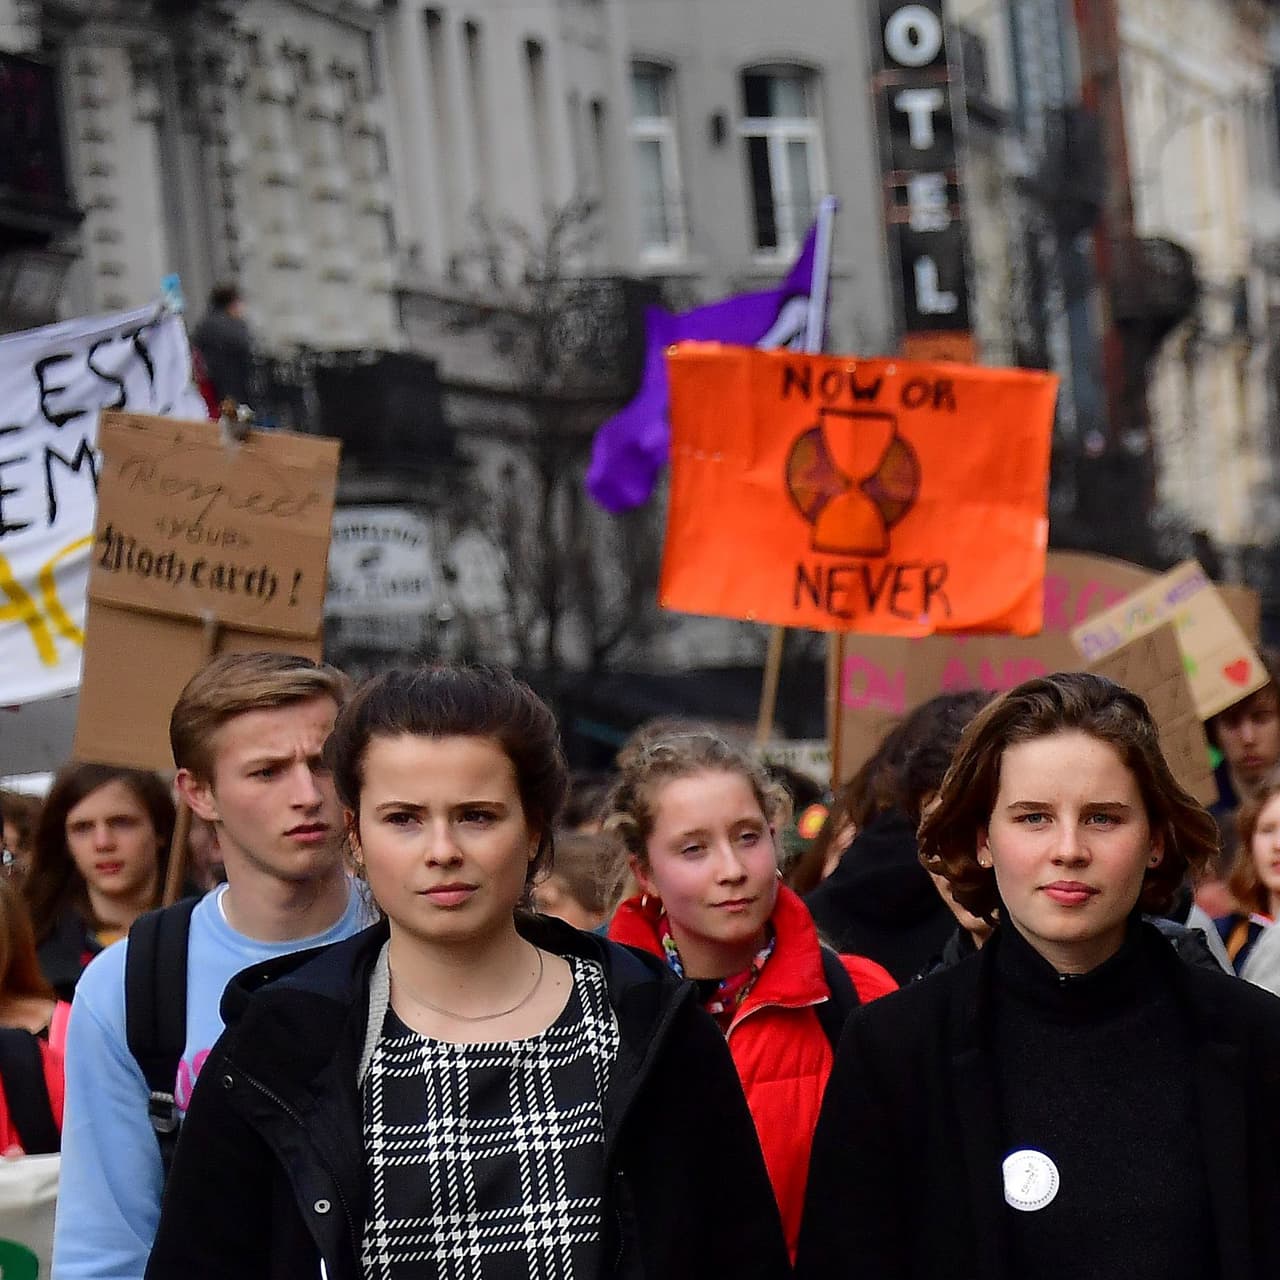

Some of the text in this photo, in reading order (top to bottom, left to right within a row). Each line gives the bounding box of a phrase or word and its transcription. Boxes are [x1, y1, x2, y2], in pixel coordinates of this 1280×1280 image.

[783, 366, 956, 412] NOW OR
[793, 562, 951, 620] NEVER
